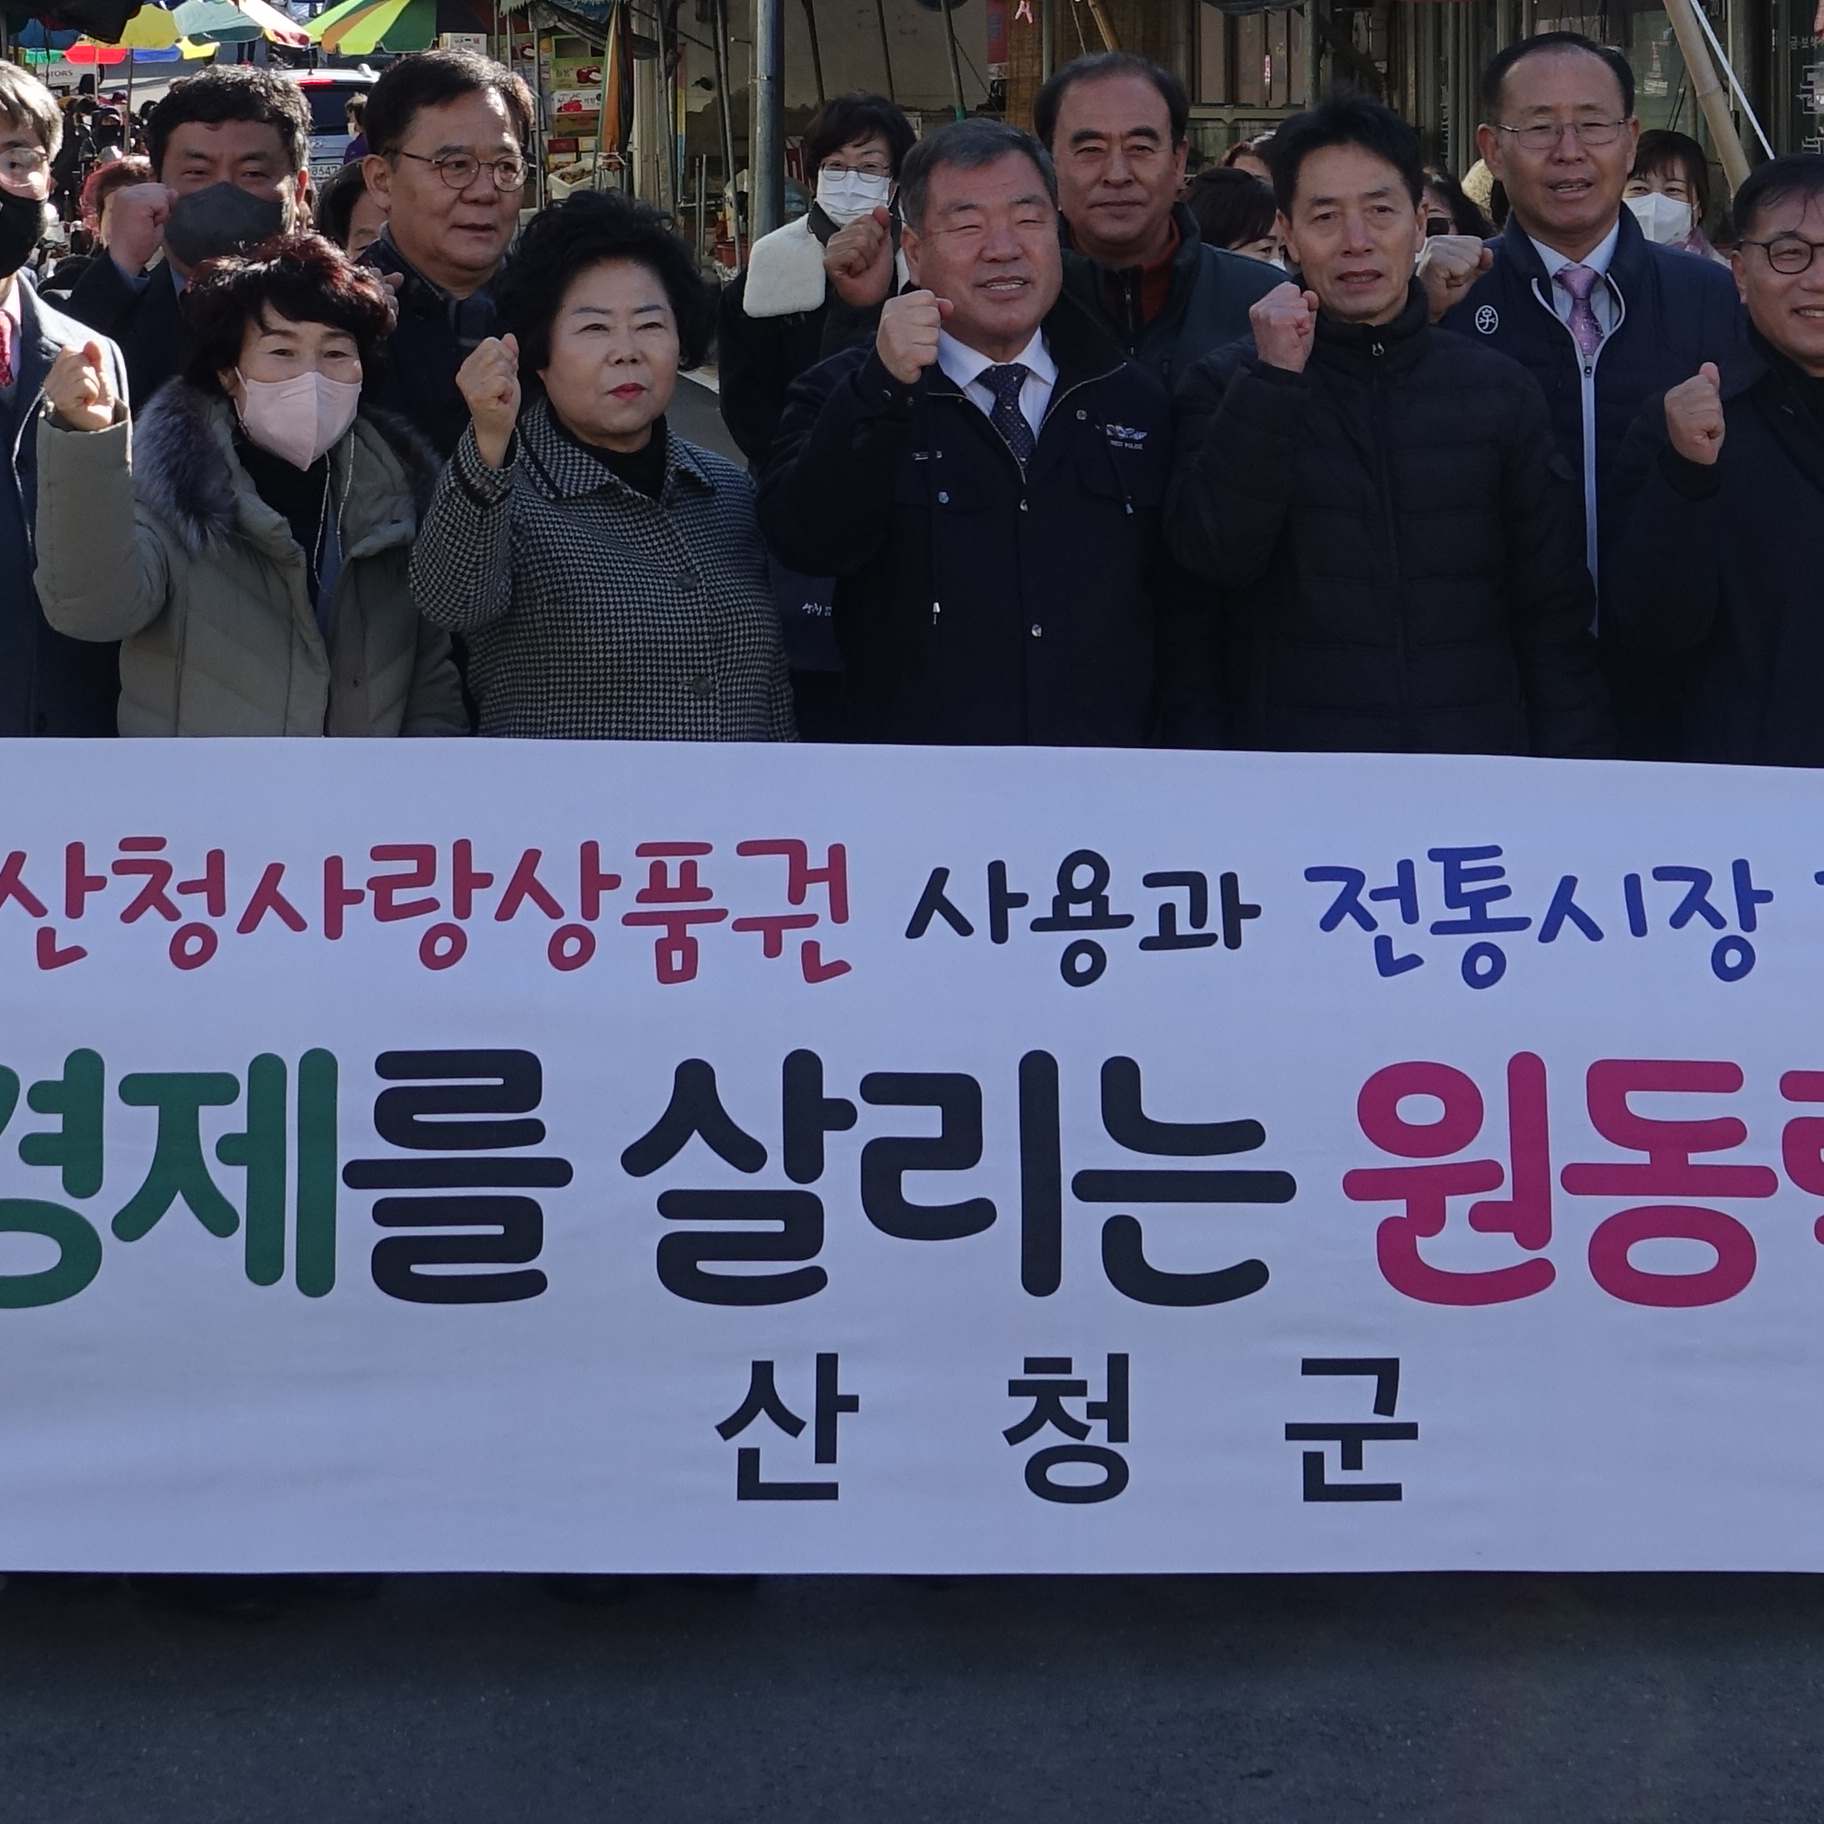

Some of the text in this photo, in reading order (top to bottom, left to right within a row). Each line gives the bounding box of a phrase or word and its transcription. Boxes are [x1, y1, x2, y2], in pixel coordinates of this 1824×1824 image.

[905, 849, 1261, 988] 사용과
[1304, 845, 1773, 990] 전통시장
[621, 1049, 1297, 1308] 살리는
